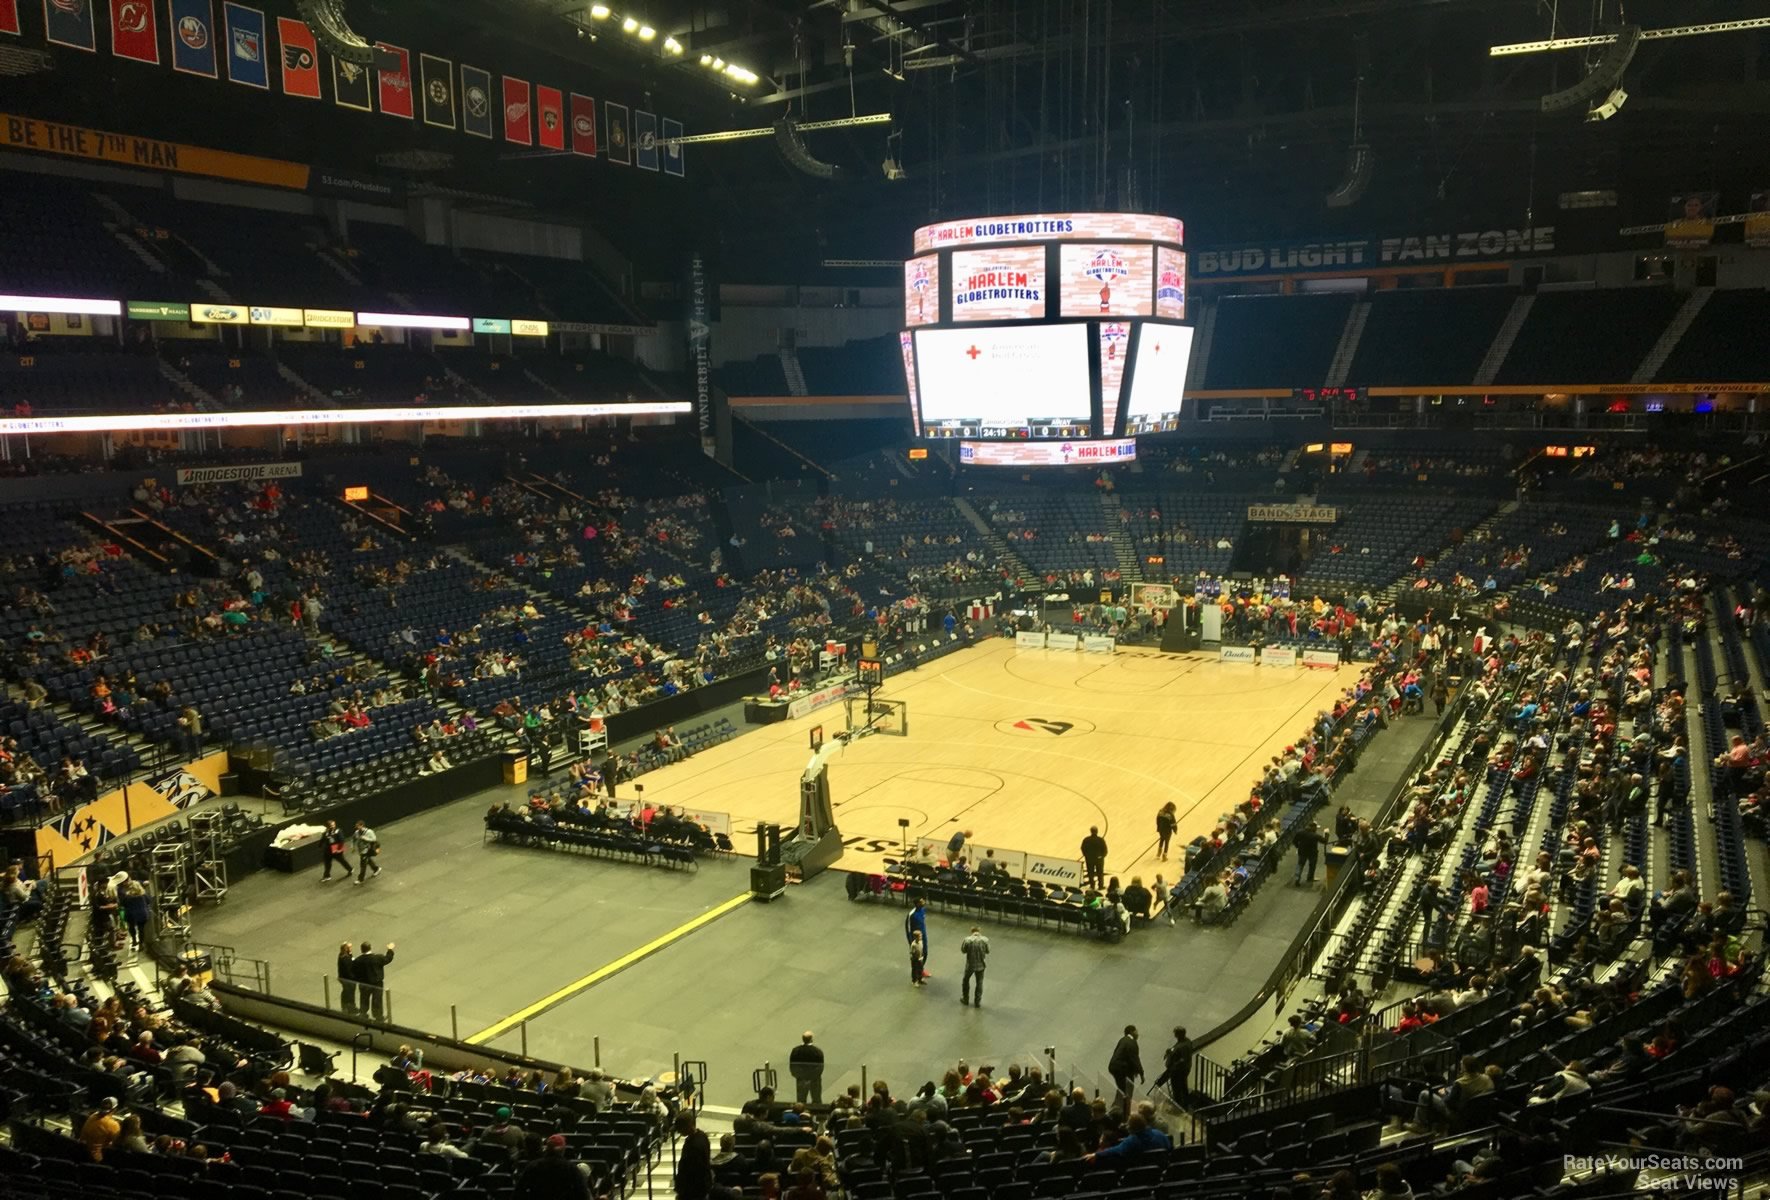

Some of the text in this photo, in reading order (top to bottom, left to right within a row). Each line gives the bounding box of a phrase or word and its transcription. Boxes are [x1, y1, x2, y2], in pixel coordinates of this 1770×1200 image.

[7, 118, 38, 147] BE
[46, 125, 87, 154] THE
[133, 139, 178, 168] MAN
[937, 220, 1073, 241] HARLEM GLOBETROTTERS
[1198, 227, 1555, 273] BUD LIGHT FAN ZONE
[1091, 259, 1122, 268] HARLEM
[693, 259, 704, 315] HEALTH
[968, 271, 1027, 290] HARLEM
[957, 289, 1039, 305] GLOBETROTTERS
[207, 308, 232, 319] Ford
[696, 344, 710, 431] VANDERBILT
[983, 428, 1007, 437] 24:19
[1078, 447, 1117, 458] HARLEM
[183, 465, 298, 482] BRIDGESTONE ARENA
[1295, 509, 1333, 518] STAGE
[1029, 861, 1077, 880] Baden
